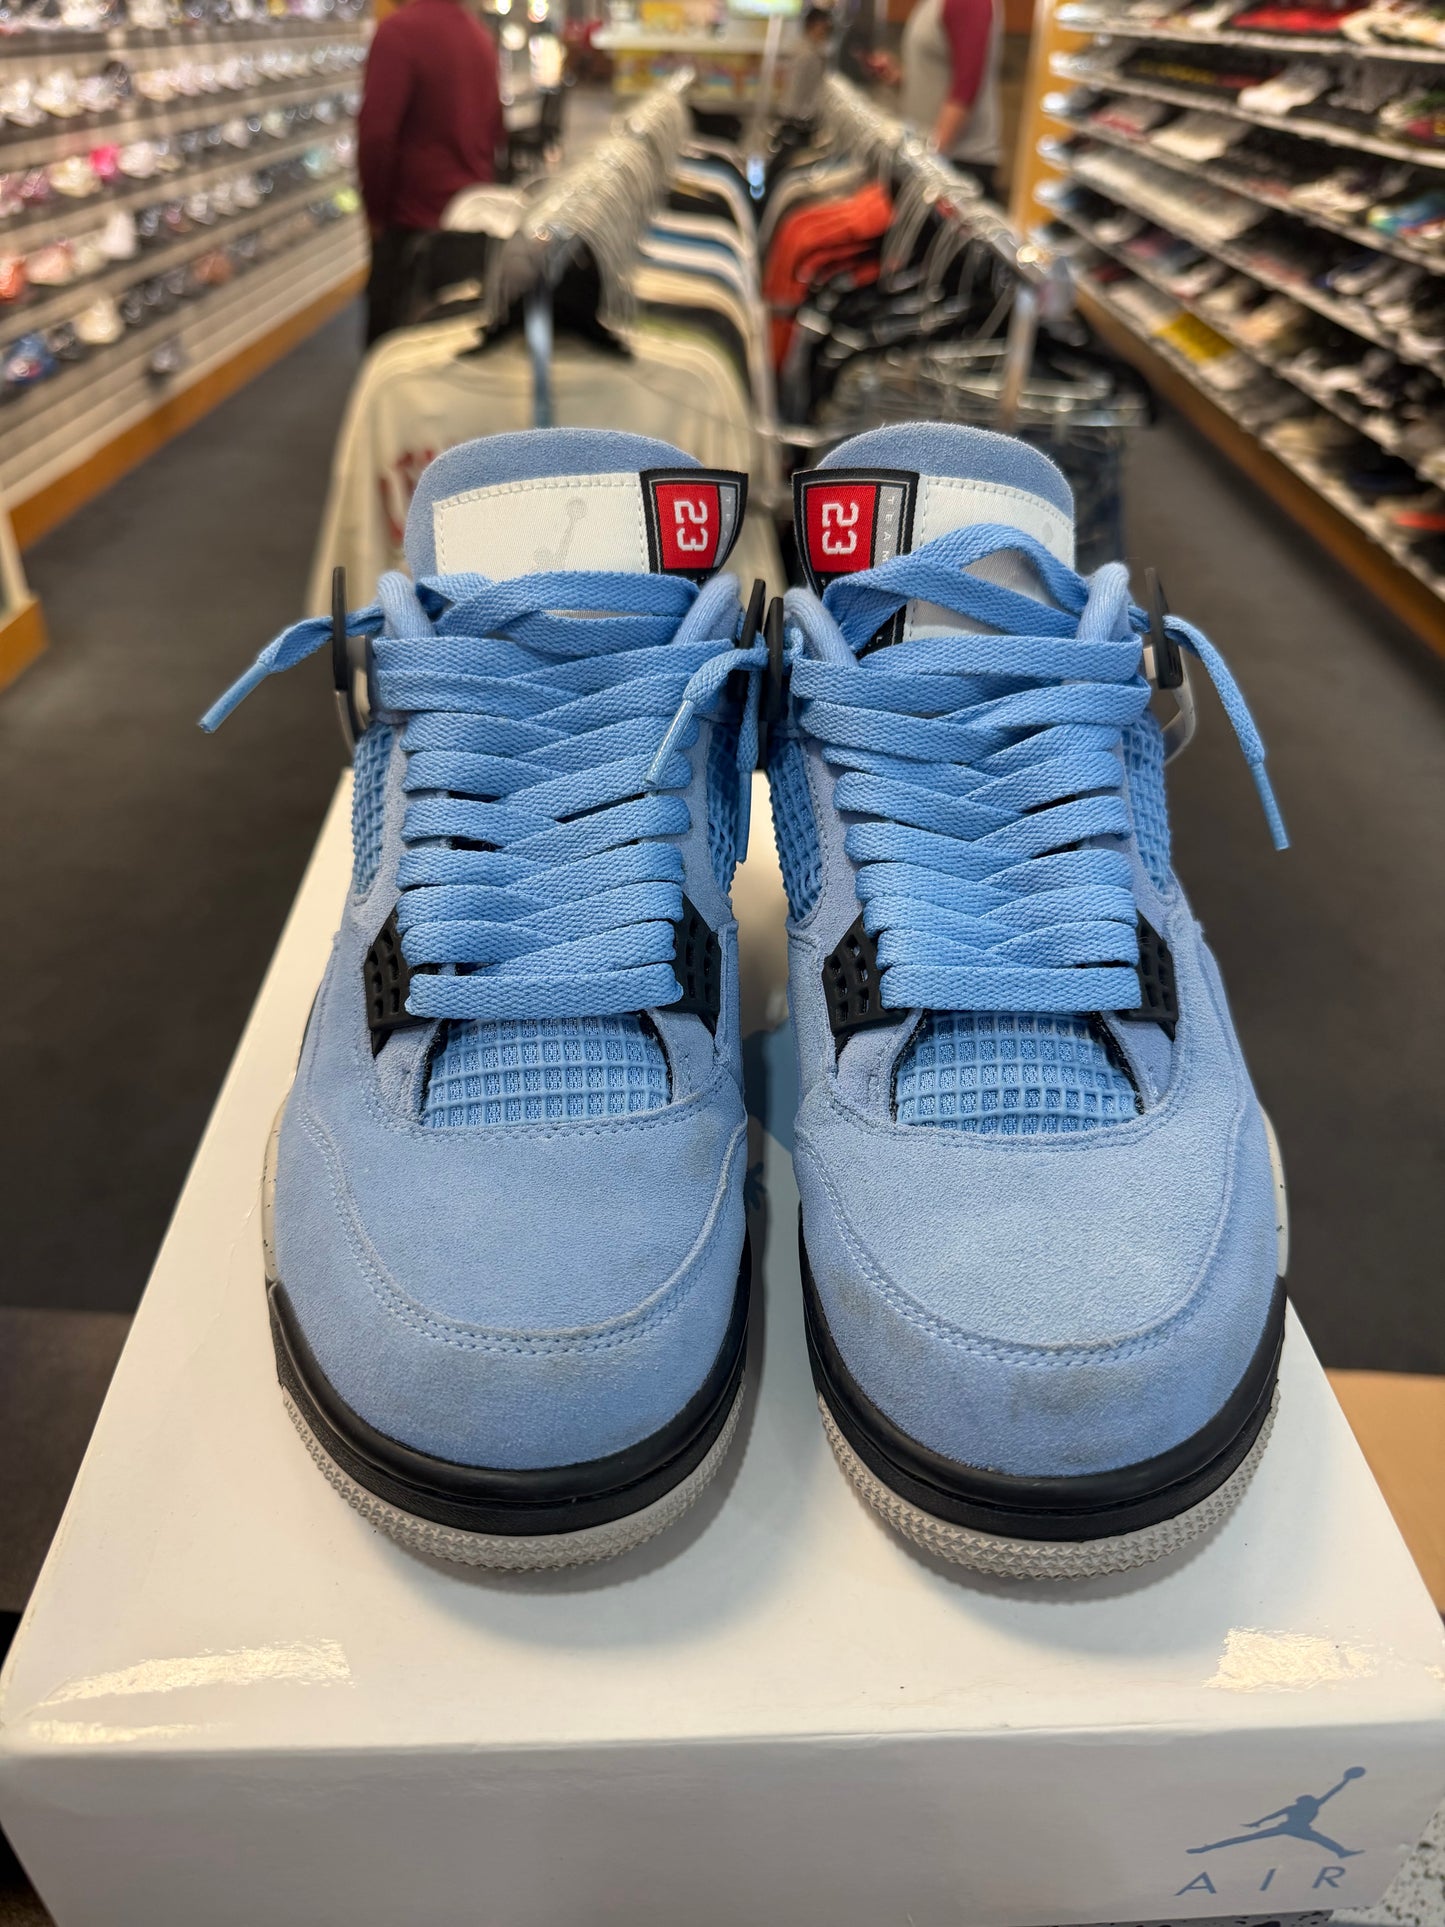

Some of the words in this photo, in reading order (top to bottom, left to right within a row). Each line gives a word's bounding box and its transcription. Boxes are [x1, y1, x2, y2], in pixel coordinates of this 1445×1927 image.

[674, 500, 708, 551] 23
[822, 502, 860, 555] 23
[881, 496, 895, 562] TEAM
[1174, 1866, 1347, 1896] AIR
